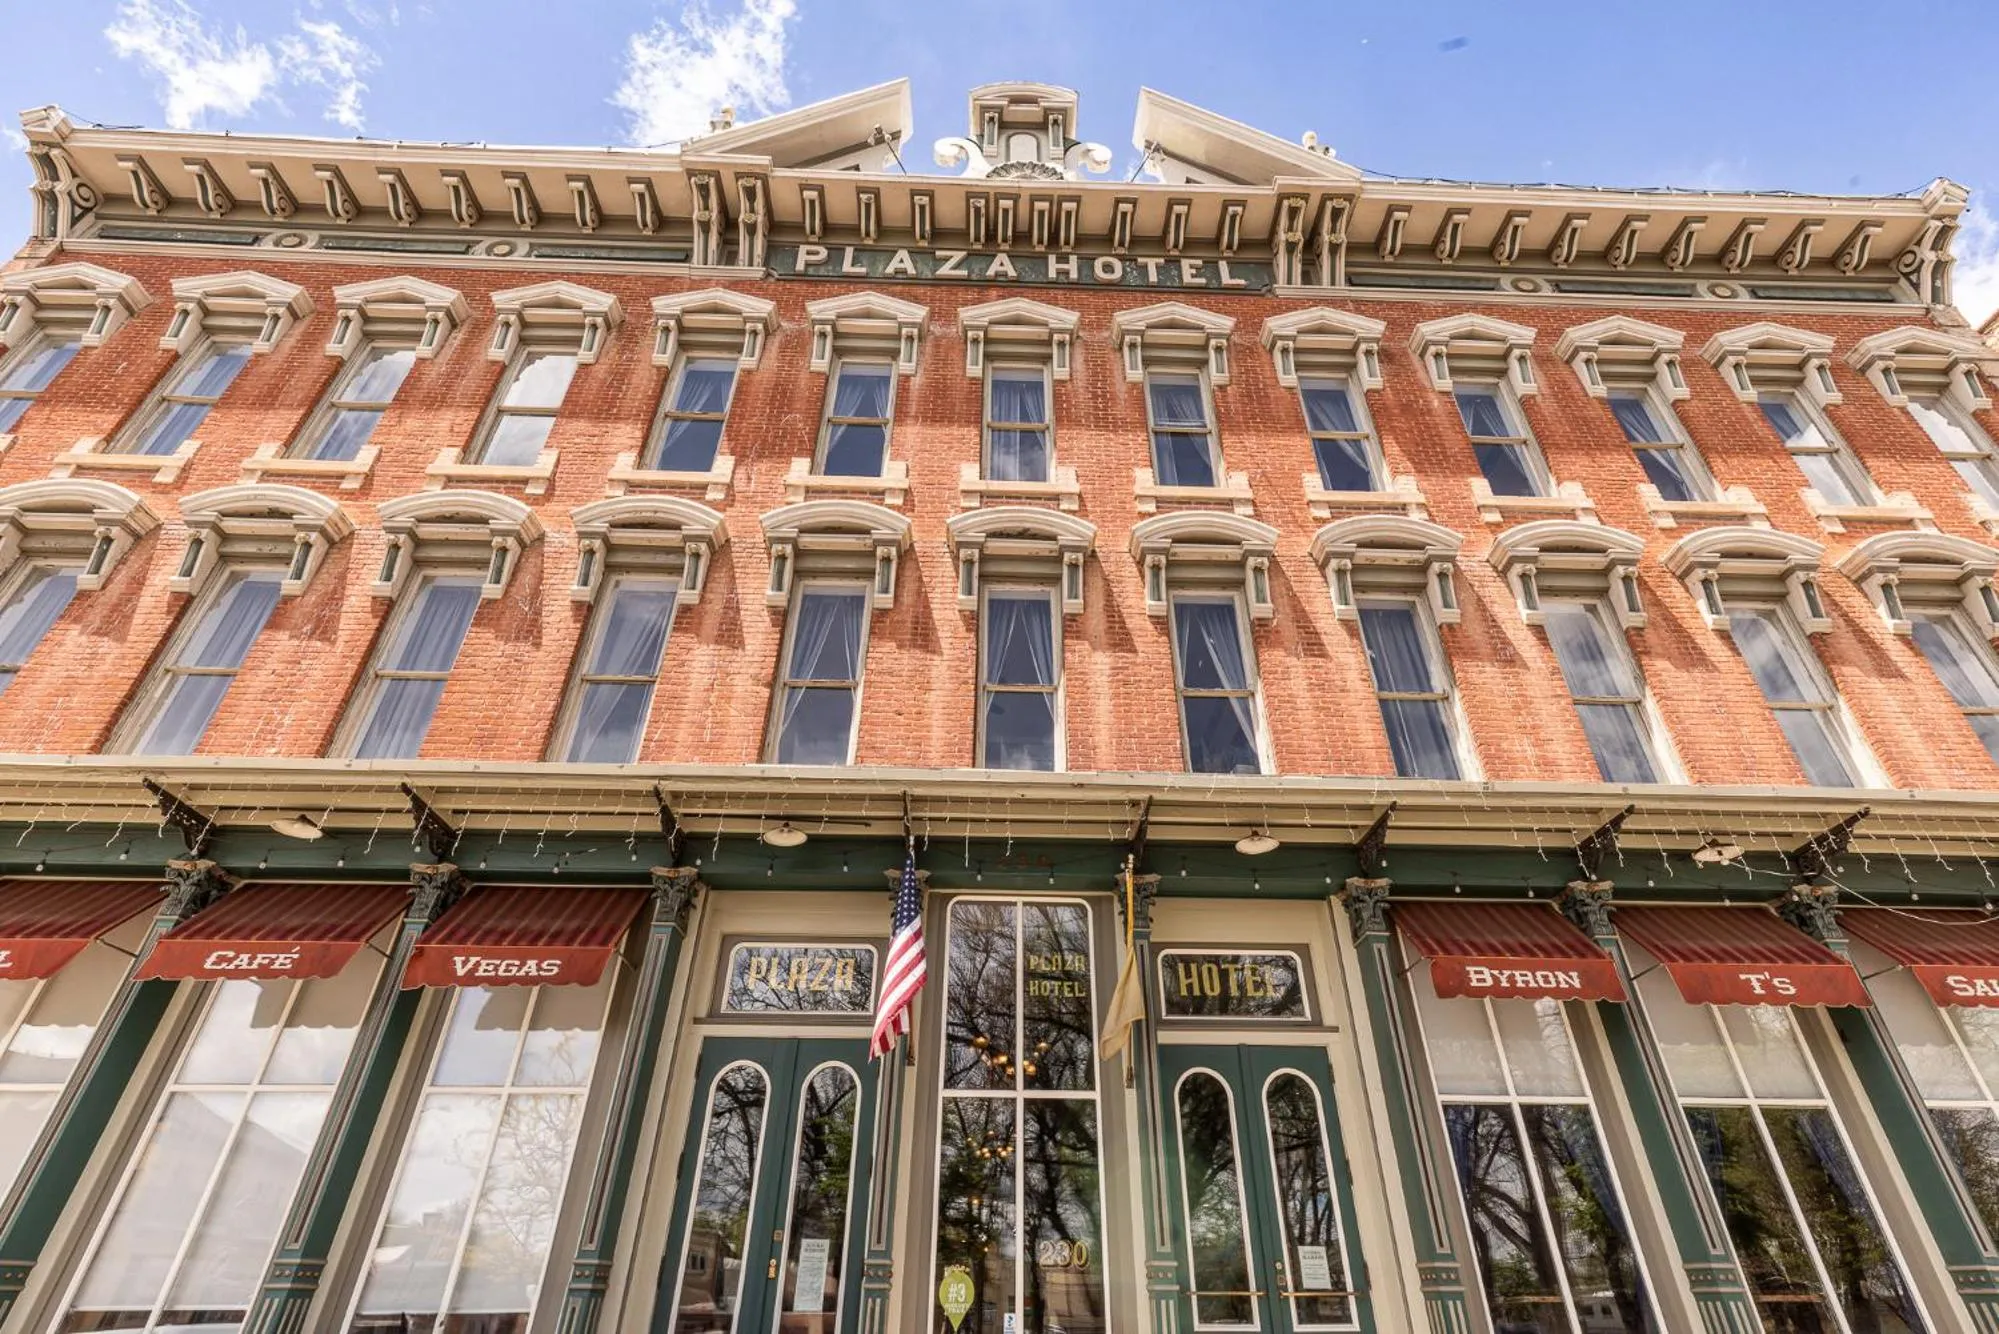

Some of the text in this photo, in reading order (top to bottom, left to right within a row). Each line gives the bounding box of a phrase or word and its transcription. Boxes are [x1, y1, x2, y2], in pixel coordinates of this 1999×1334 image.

[794, 244, 1248, 288] PLAZA HOTEL
[203, 945, 301, 970] CAFÉ
[452, 955, 562, 977] VEGAS
[1028, 952, 1087, 972] PLAZA
[747, 956, 857, 992] PLAZA
[1177, 961, 1283, 997] HOTEL
[1465, 965, 1582, 989] BYRON
[1738, 970, 1798, 996] T'S
[1028, 979, 1087, 998] HOTEL
[1039, 1240, 1090, 1270] 230
